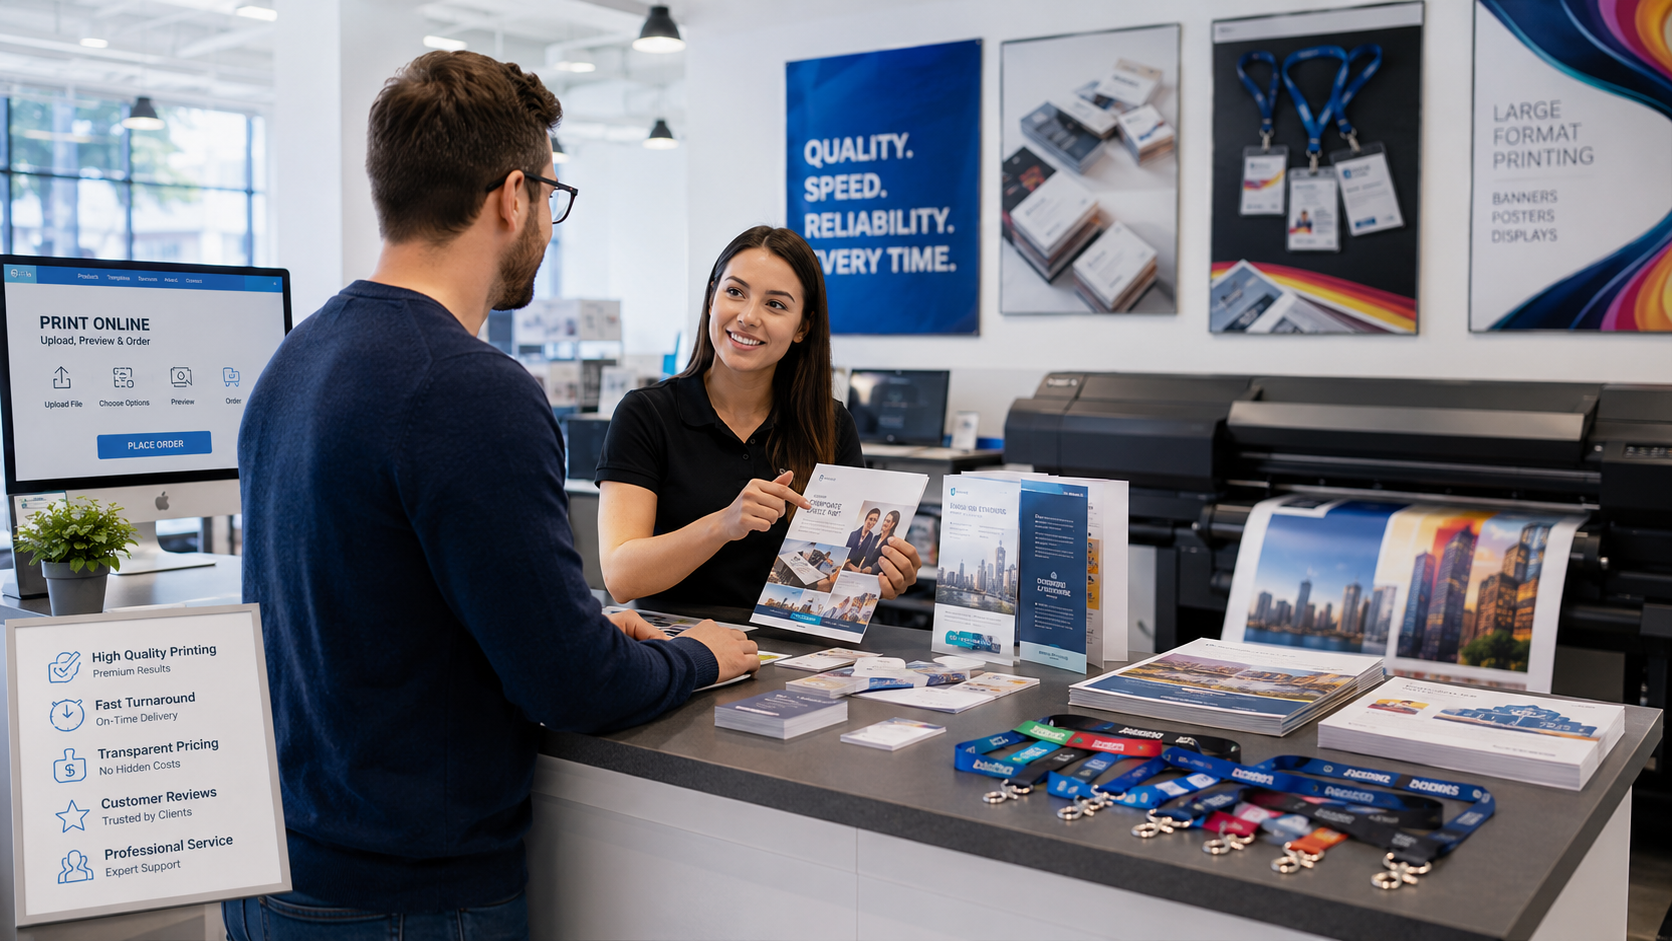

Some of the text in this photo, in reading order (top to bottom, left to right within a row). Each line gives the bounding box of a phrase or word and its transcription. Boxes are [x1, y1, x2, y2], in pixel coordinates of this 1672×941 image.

[1493, 100, 1562, 123] LARGE
[1493, 122, 1582, 146] FORMAT
[803, 132, 914, 169] QUALITY.
[1493, 146, 1594, 170] PRINTING
[804, 173, 888, 202] SPEED.
[1492, 189, 1558, 206] BANNERS
[804, 207, 955, 239] RELIABILITY.
[1492, 208, 1555, 225] POSTERS
[1491, 228, 1558, 244] DISPLAYS
[814, 246, 957, 275] VERY TIME.
[40, 315, 151, 332] PRINT ONLINE
[40, 335, 151, 347] Upload, Preview & Order
[44, 400, 83, 410] Upload File
[125, 399, 150, 409] Options
[170, 398, 195, 406] Preview
[225, 397, 242, 405] Order
[127, 439, 184, 451] PLACE ORDER
[92, 644, 217, 665] High Quality Printing
[92, 663, 171, 679] Premium Results
[95, 692, 196, 711] Fast Turnaround
[95, 711, 179, 727] On-Time Delivery
[98, 738, 219, 761] Transparent Pricing
[99, 759, 181, 776] No Hidden Costs
[101, 788, 217, 810] Customer Reviews
[102, 807, 193, 827] Trusted by Clients
[104, 835, 234, 861] Professional Service
[105, 860, 181, 878] Expert Support
